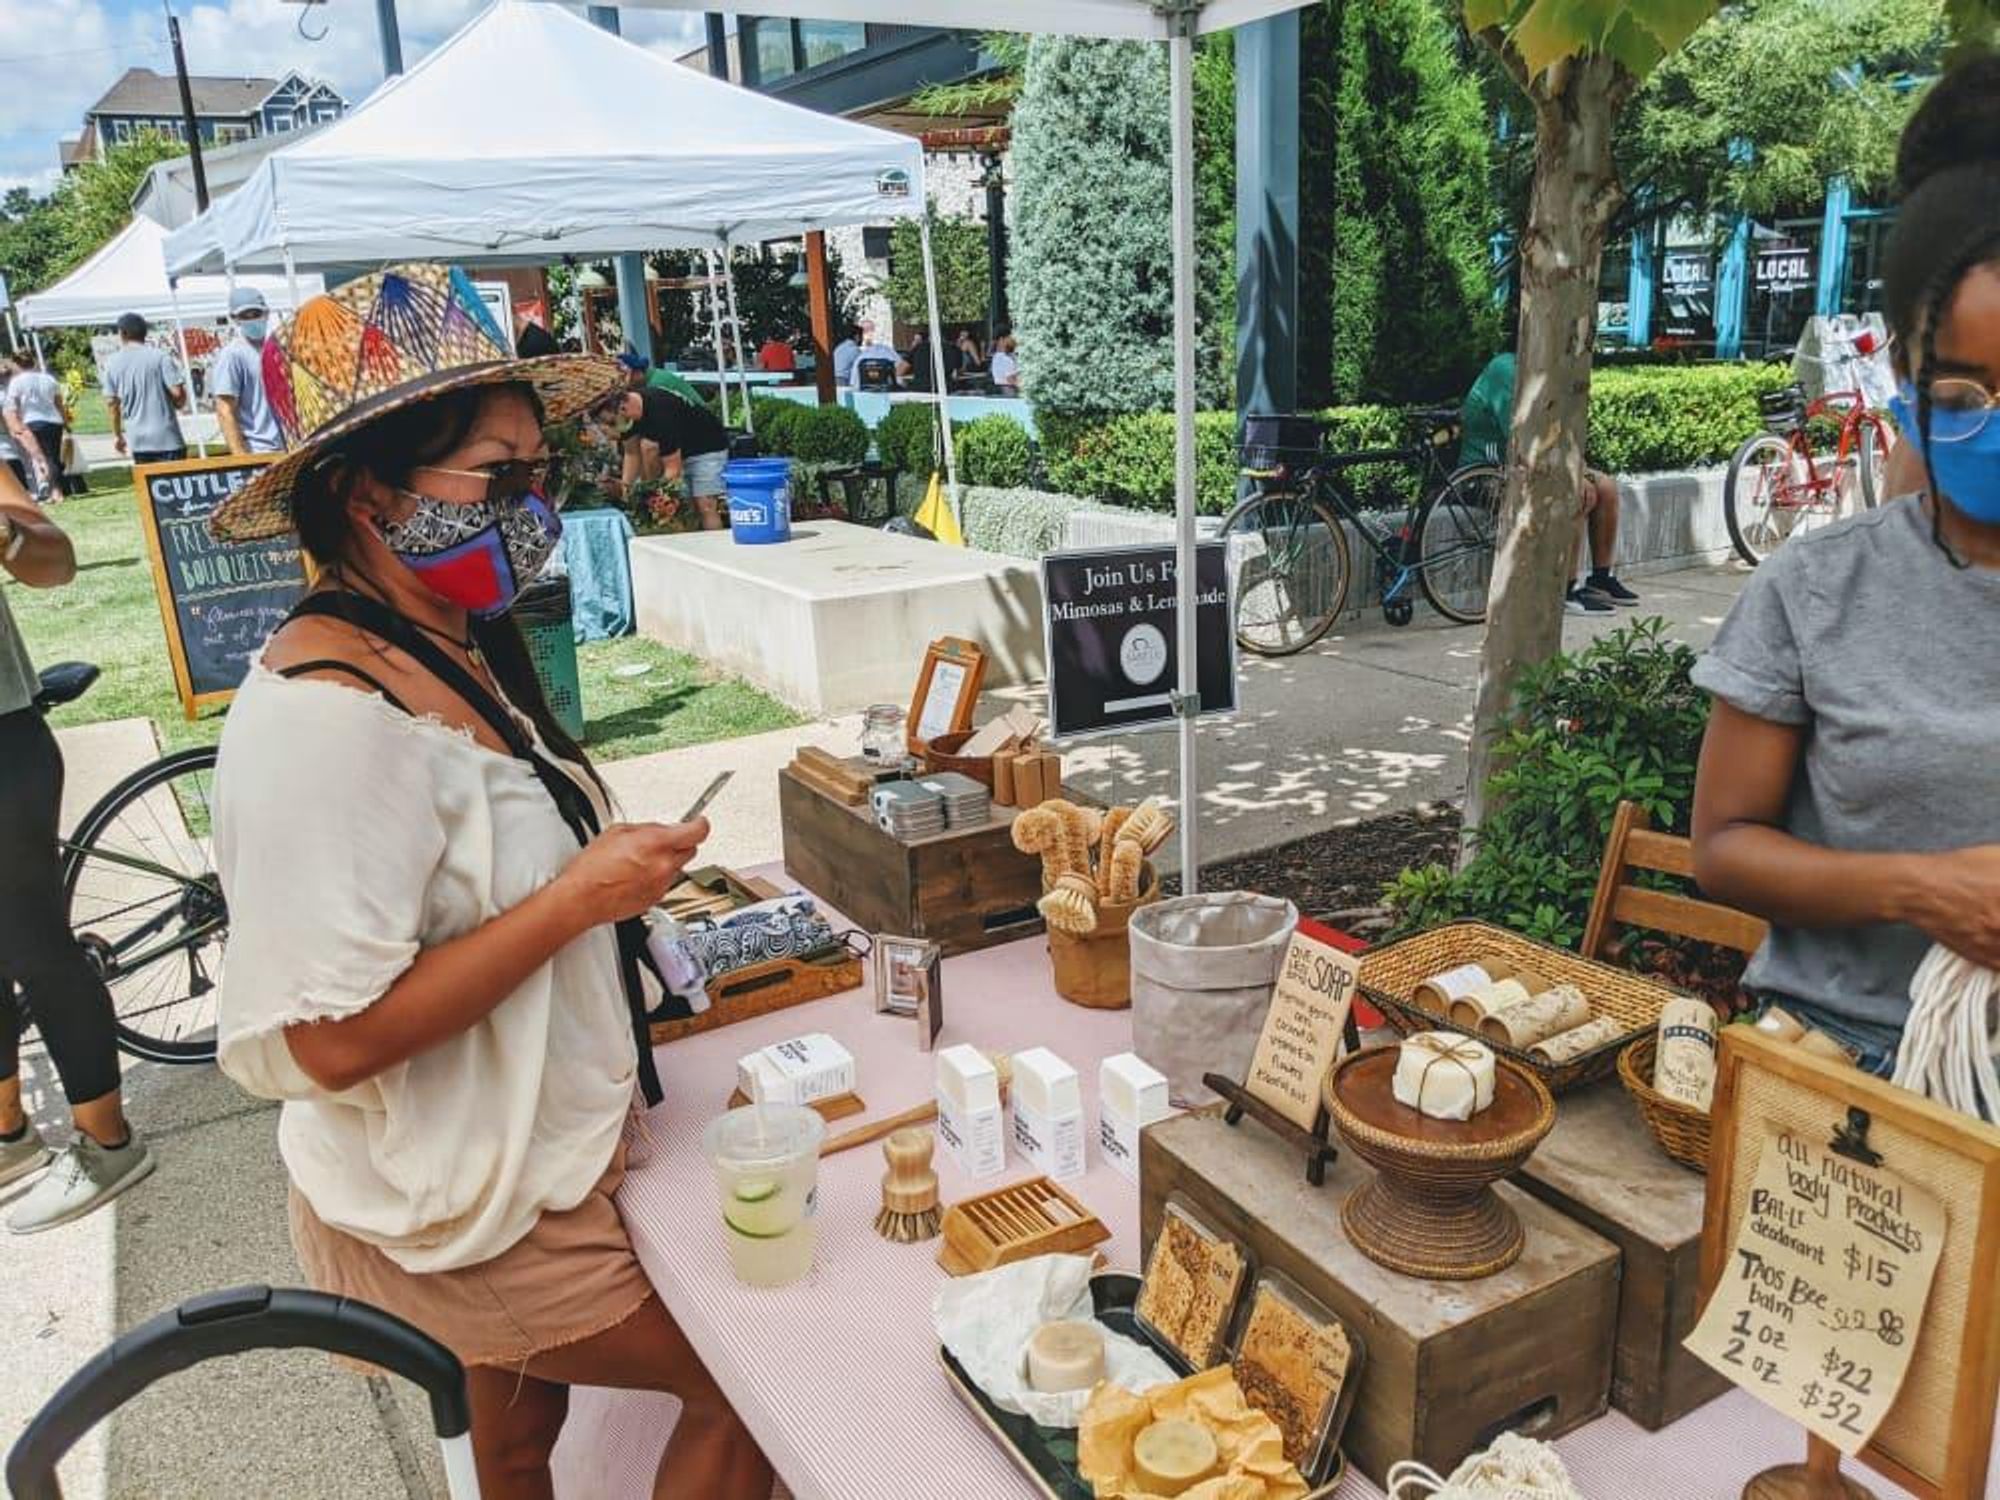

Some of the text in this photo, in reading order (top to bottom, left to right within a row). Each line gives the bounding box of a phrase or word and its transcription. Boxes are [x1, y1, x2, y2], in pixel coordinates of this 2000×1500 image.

[1663, 260, 1710, 283] LOCAL
[1757, 258, 1809, 280] LOCAL
[151, 468, 266, 503] CUTLE
[180, 551, 272, 592] BOUQUETS
[1084, 566, 1124, 595] Join
[1128, 562, 1155, 584] Us
[1052, 600, 1124, 621] Mimosas
[1129, 597, 1144, 612] &
[1308, 956, 1353, 1003] SOAP
[1778, 1133, 1902, 1215] all natural
[1787, 1163, 1830, 1219] body
[1750, 1216, 1900, 1287] deodorant $15
[1738, 1248, 1828, 1310] TAOS Bee
[1749, 1282, 1794, 1324] balm
[1731, 1309, 1873, 1396] 1 oz $22
[1721, 1337, 1864, 1436] 2 oz $32
